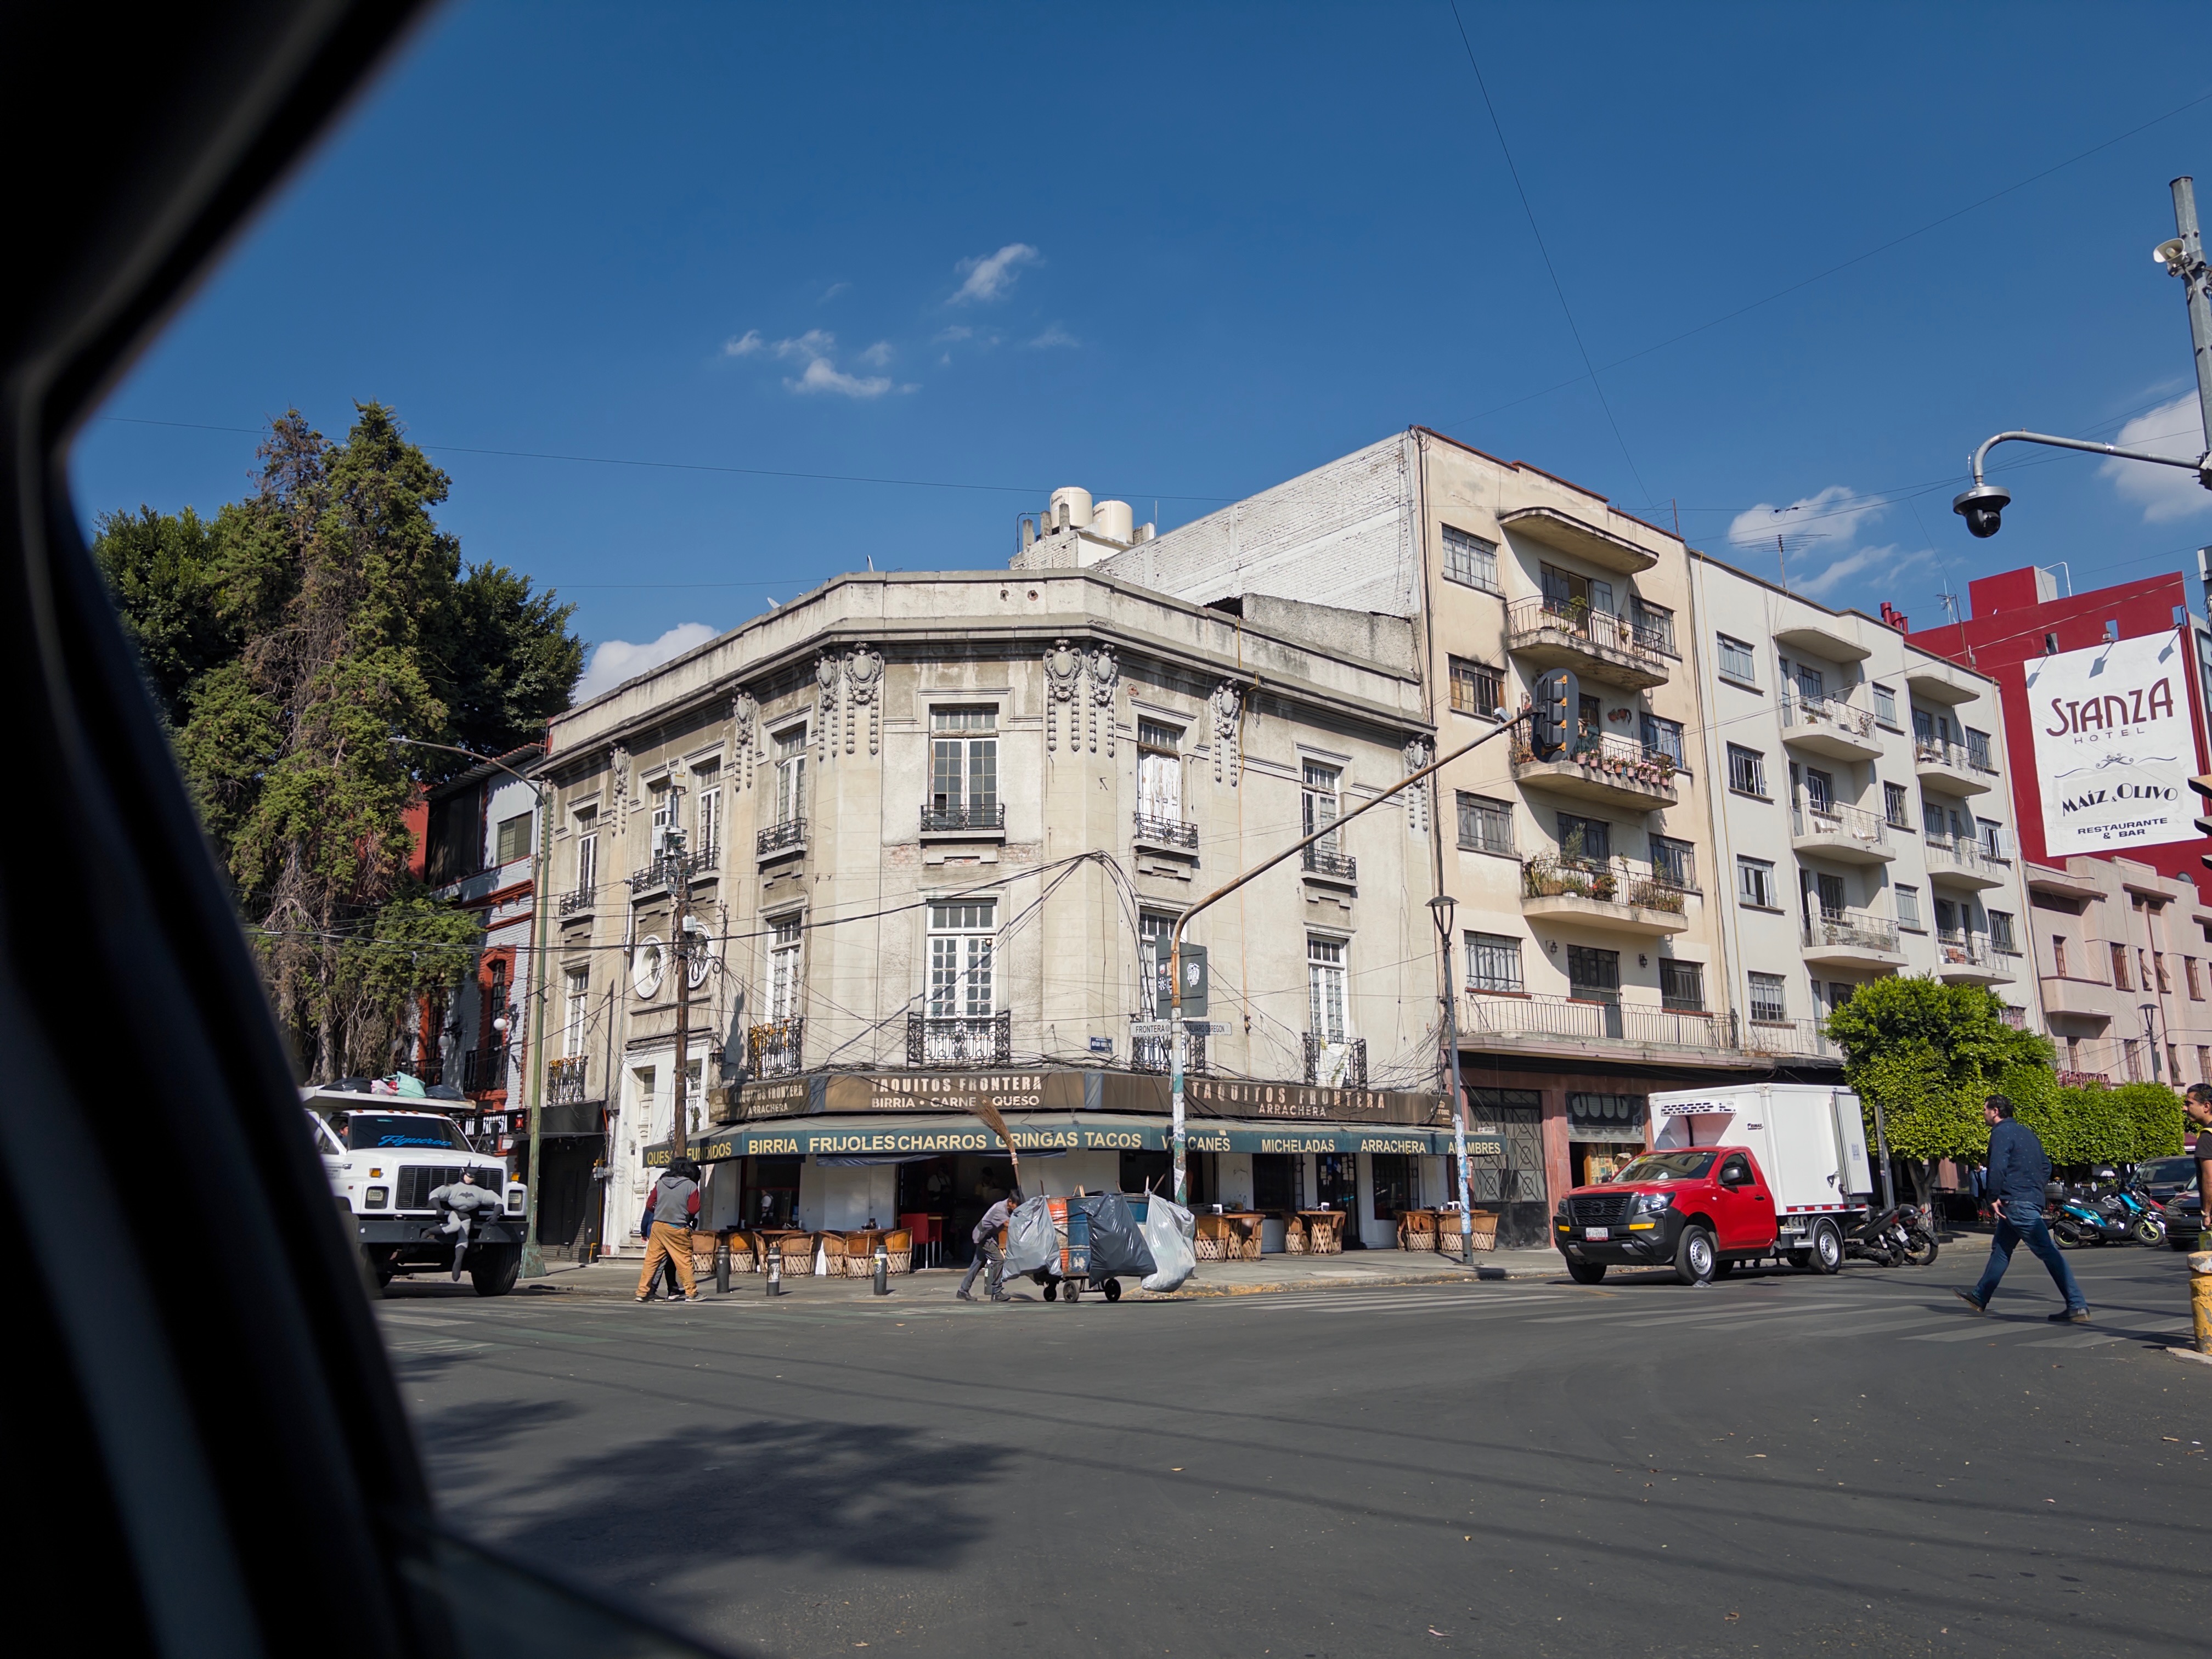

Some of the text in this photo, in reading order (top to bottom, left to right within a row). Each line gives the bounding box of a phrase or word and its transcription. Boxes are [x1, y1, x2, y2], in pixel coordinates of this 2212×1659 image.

[2046, 677, 2174, 737] STANZA
[2074, 727, 2145, 744] HOTEL
[2062, 789, 2108, 817] MAÍZ
[2117, 783, 2178, 801] OLIVO
[2078, 817, 2168, 834] RESTAURANTE
[2119, 829, 2146, 837] BAR
[1136, 1024, 1165, 1034] FRONTERA
[1189, 1024, 1205, 1032] ALVARO
[871, 1076, 1042, 1093] TAQUITOS FRONTERA
[735, 1084, 803, 1103] TAQUITOS FRONTERA
[1192, 1082, 1385, 1109] TAQUITOS FRONTERA
[748, 1102, 788, 1115] ARRACHERA
[872, 1096, 1040, 1108] BIRRIA CARNE QUESO
[1259, 1103, 1326, 1116] ARRACHERA
[377, 1135, 453, 1147] Figueroa
[749, 1138, 798, 1154] BIRRIA
[810, 1134, 987, 1153] FRIJOLES CHARROS
[995, 1131, 1142, 1148] GRINGAS TACOS
[1262, 1139, 1335, 1153] MICHELADAS
[1361, 1139, 1426, 1153] ARRACHERA
[687, 1142, 732, 1161] FUNDIDOS
